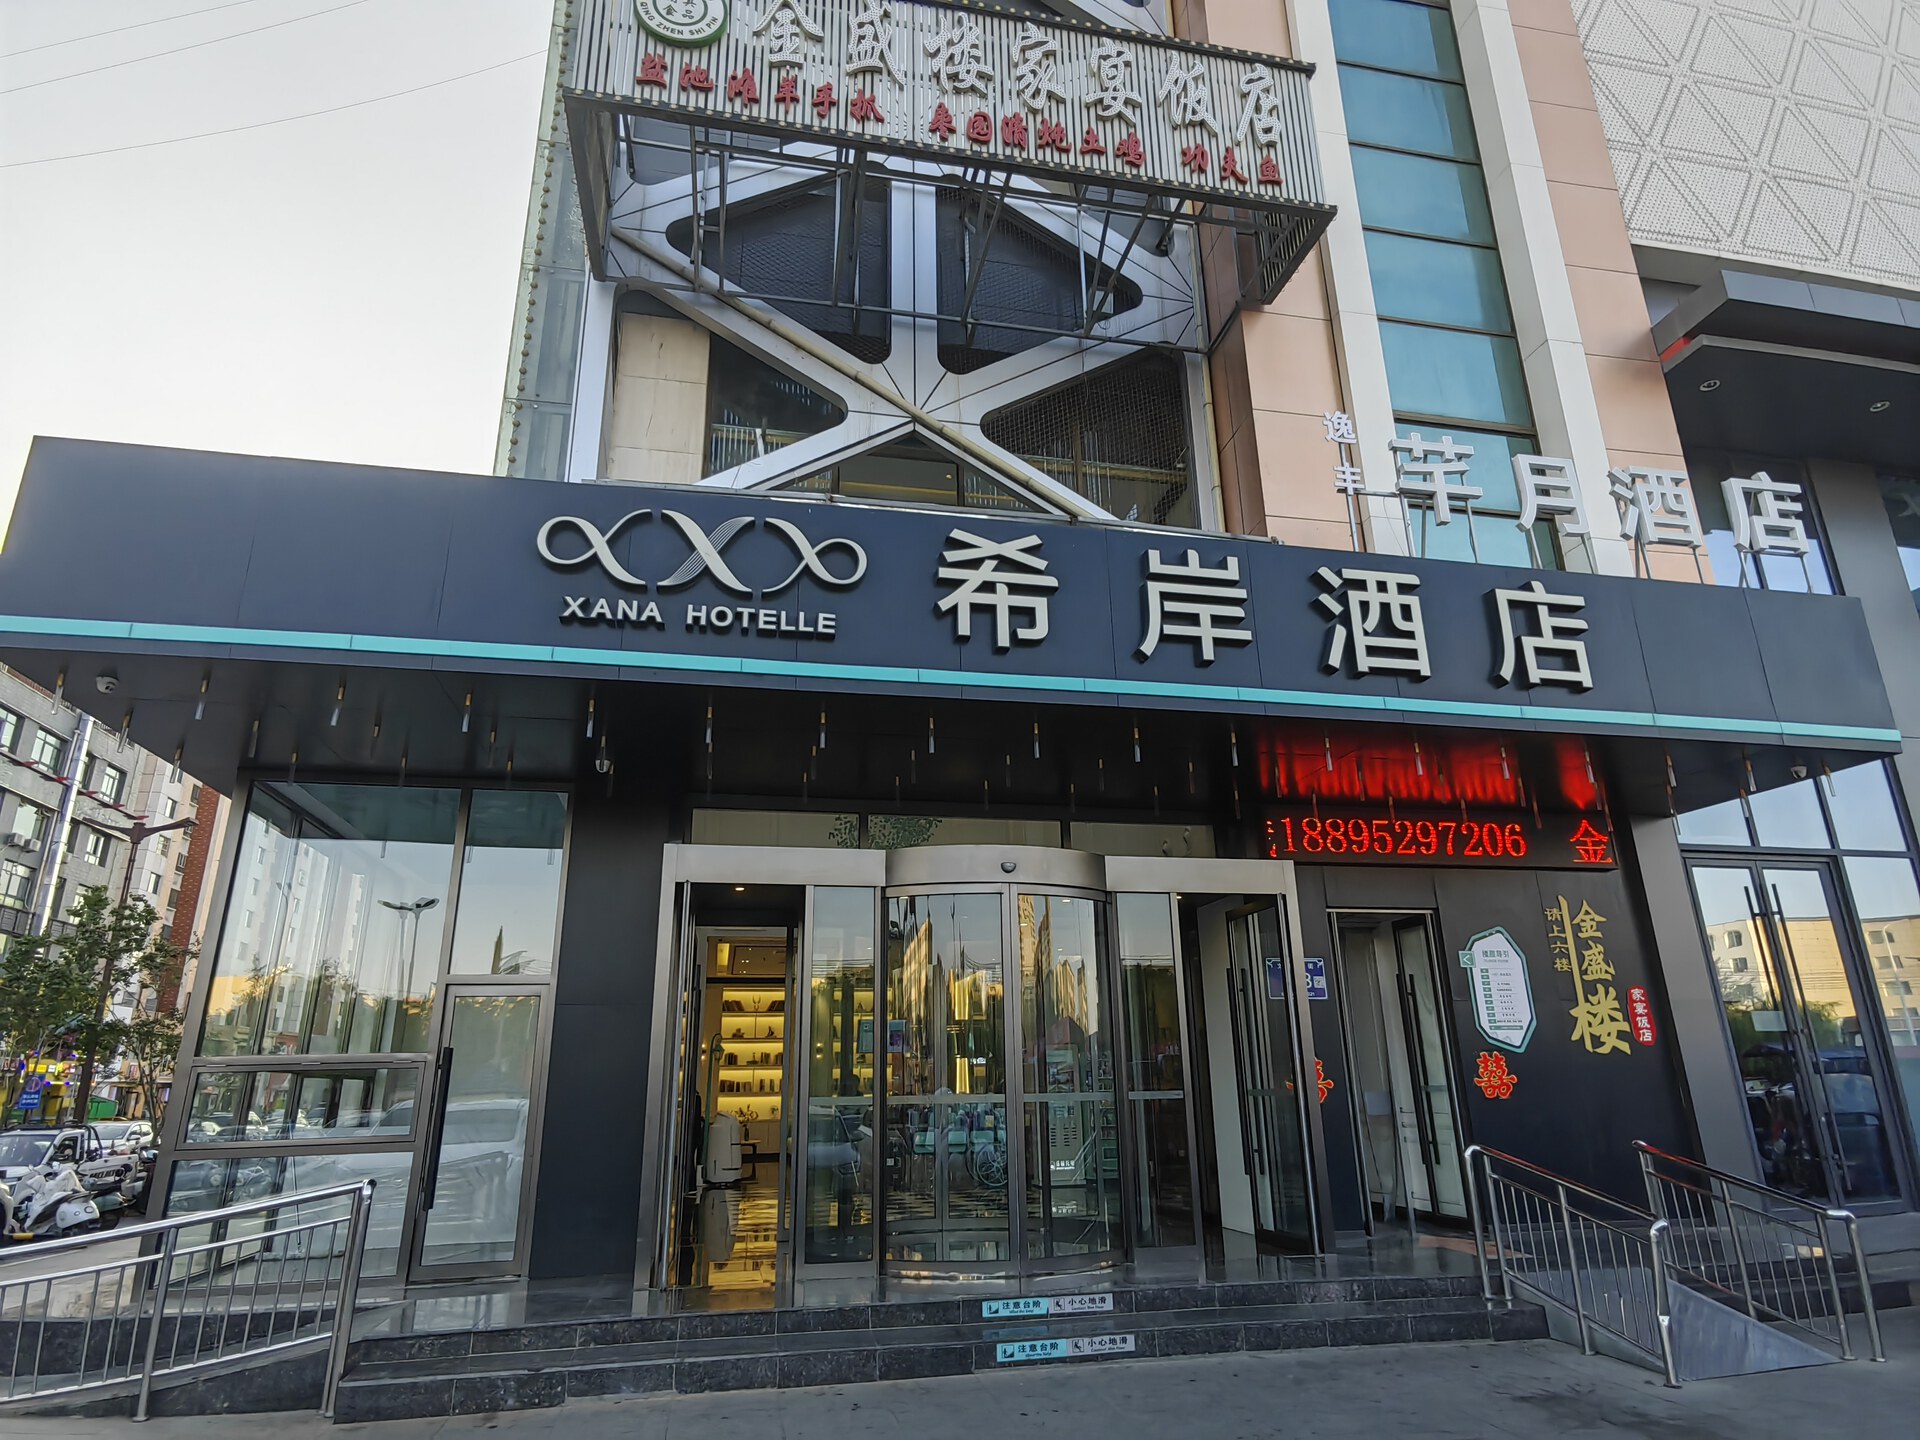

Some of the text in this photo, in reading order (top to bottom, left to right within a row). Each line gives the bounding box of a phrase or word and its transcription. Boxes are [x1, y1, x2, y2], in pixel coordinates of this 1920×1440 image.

[640, 1, 656, 21] QING
[656, 21, 684, 36] ZHEN
[688, 27, 705, 36] SHI
[705, 16, 719, 29] PIN
[1181, 142, 1284, 186] 功夫鱼
[1322, 410, 1365, 496] 逸丰
[1388, 431, 1810, 557] 芊月酒店
[560, 595, 837, 640] XANA HOTELLE
[934, 527, 1594, 692] 希岸酒店
[1281, 817, 1527, 857] 18895297206
[1570, 819, 1612, 864] 金
[1544, 907, 1573, 973] 请上六楼
[1568, 899, 1632, 1056] 金盛楼
[1630, 987, 1653, 1042] 家宴饭店
[1002, 1299, 1042, 1310] 注意台阶
[1068, 1295, 1107, 1306] 小心地滑
[1017, 1342, 1059, 1353] 注意台阶
[1087, 1337, 1128, 1348] 小心地滑
